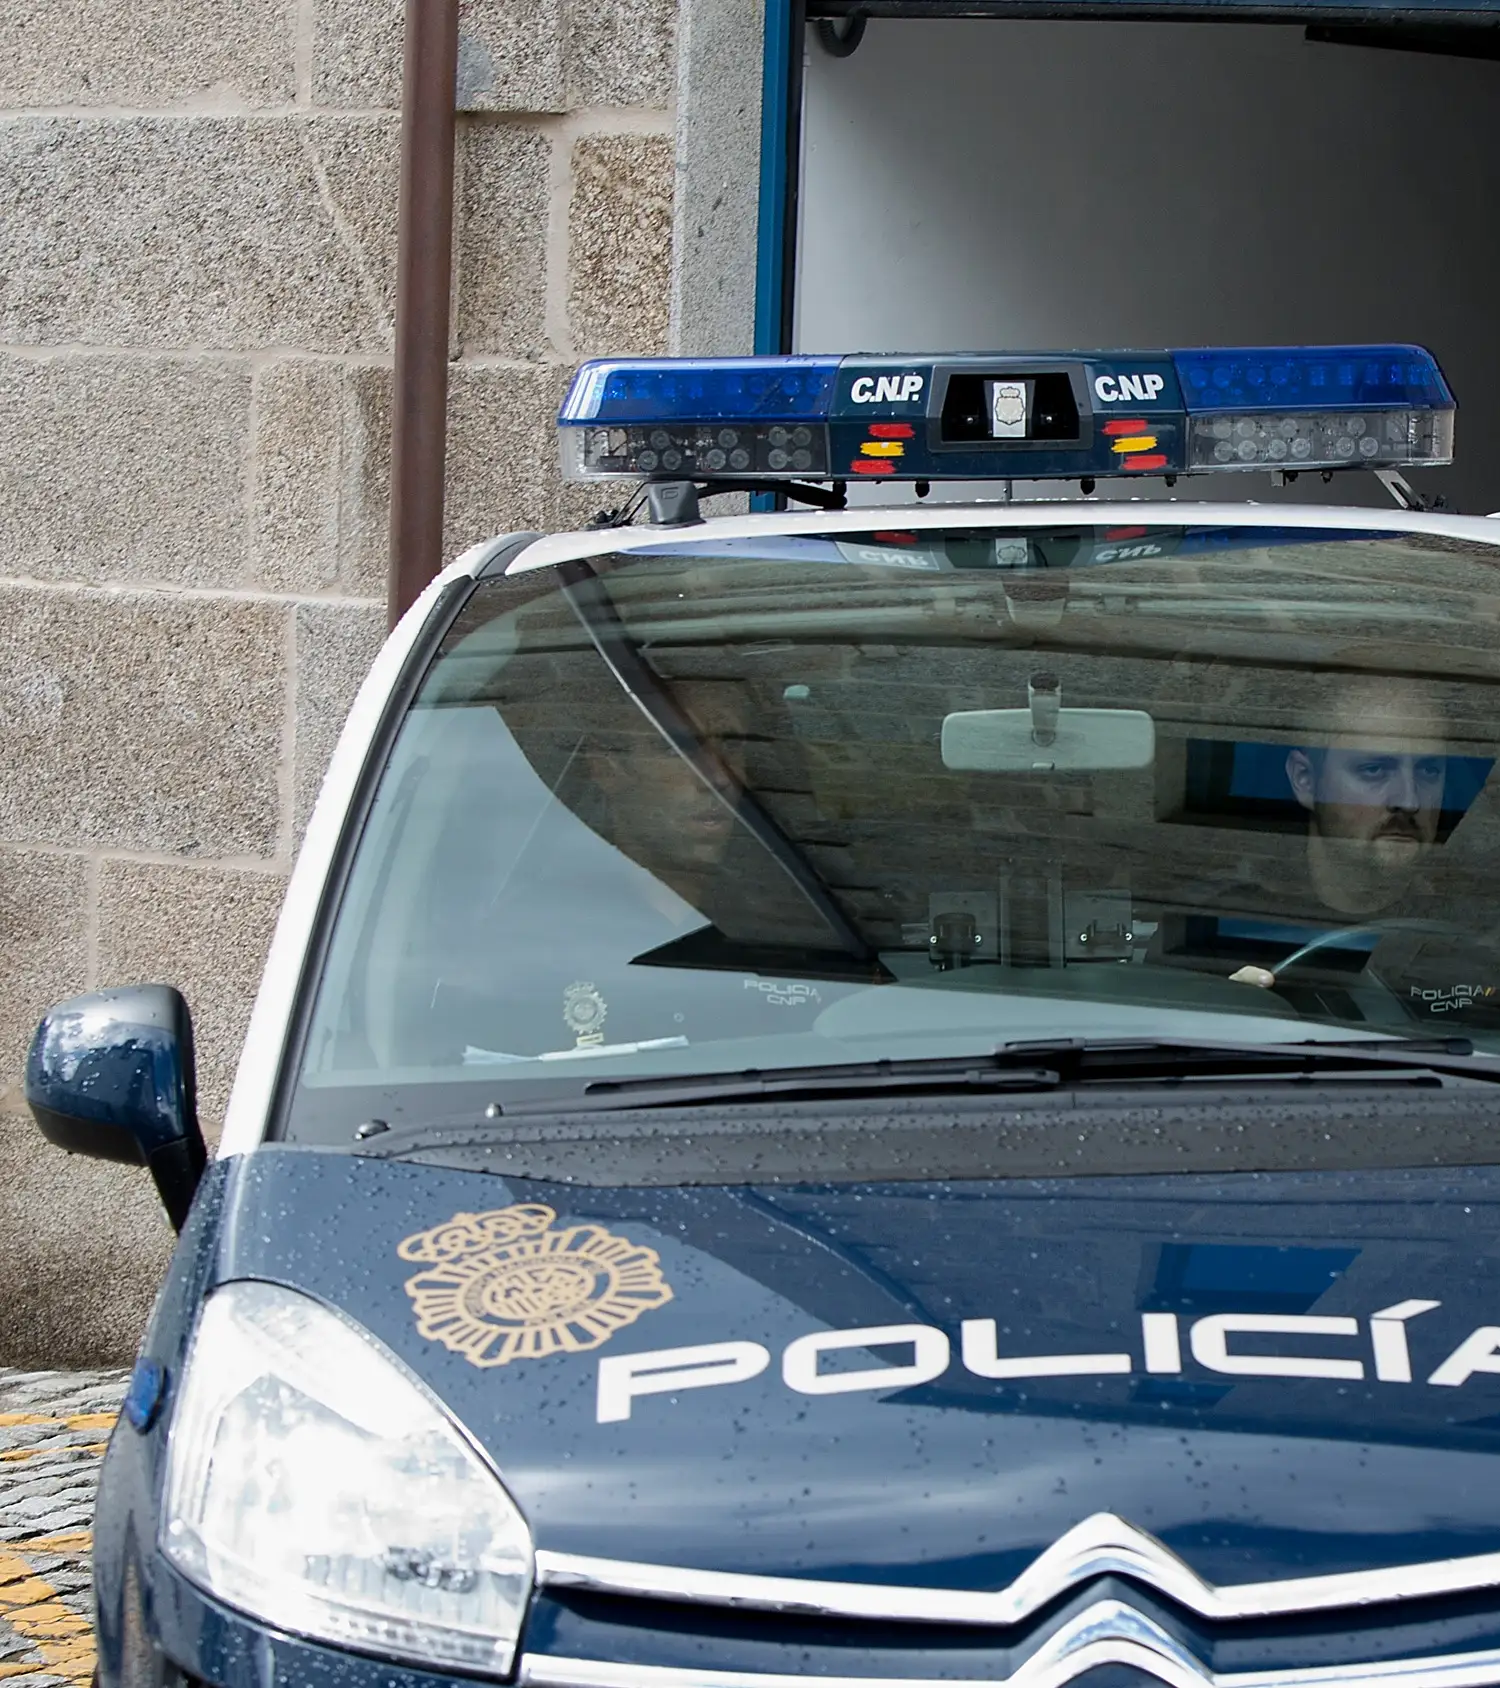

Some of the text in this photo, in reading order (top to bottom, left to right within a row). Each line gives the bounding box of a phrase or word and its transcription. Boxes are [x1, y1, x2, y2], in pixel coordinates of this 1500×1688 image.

[851, 375, 924, 403] C.N.P.
[766, 994, 806, 1006] CNP
[1430, 998, 1473, 1013] CNP
